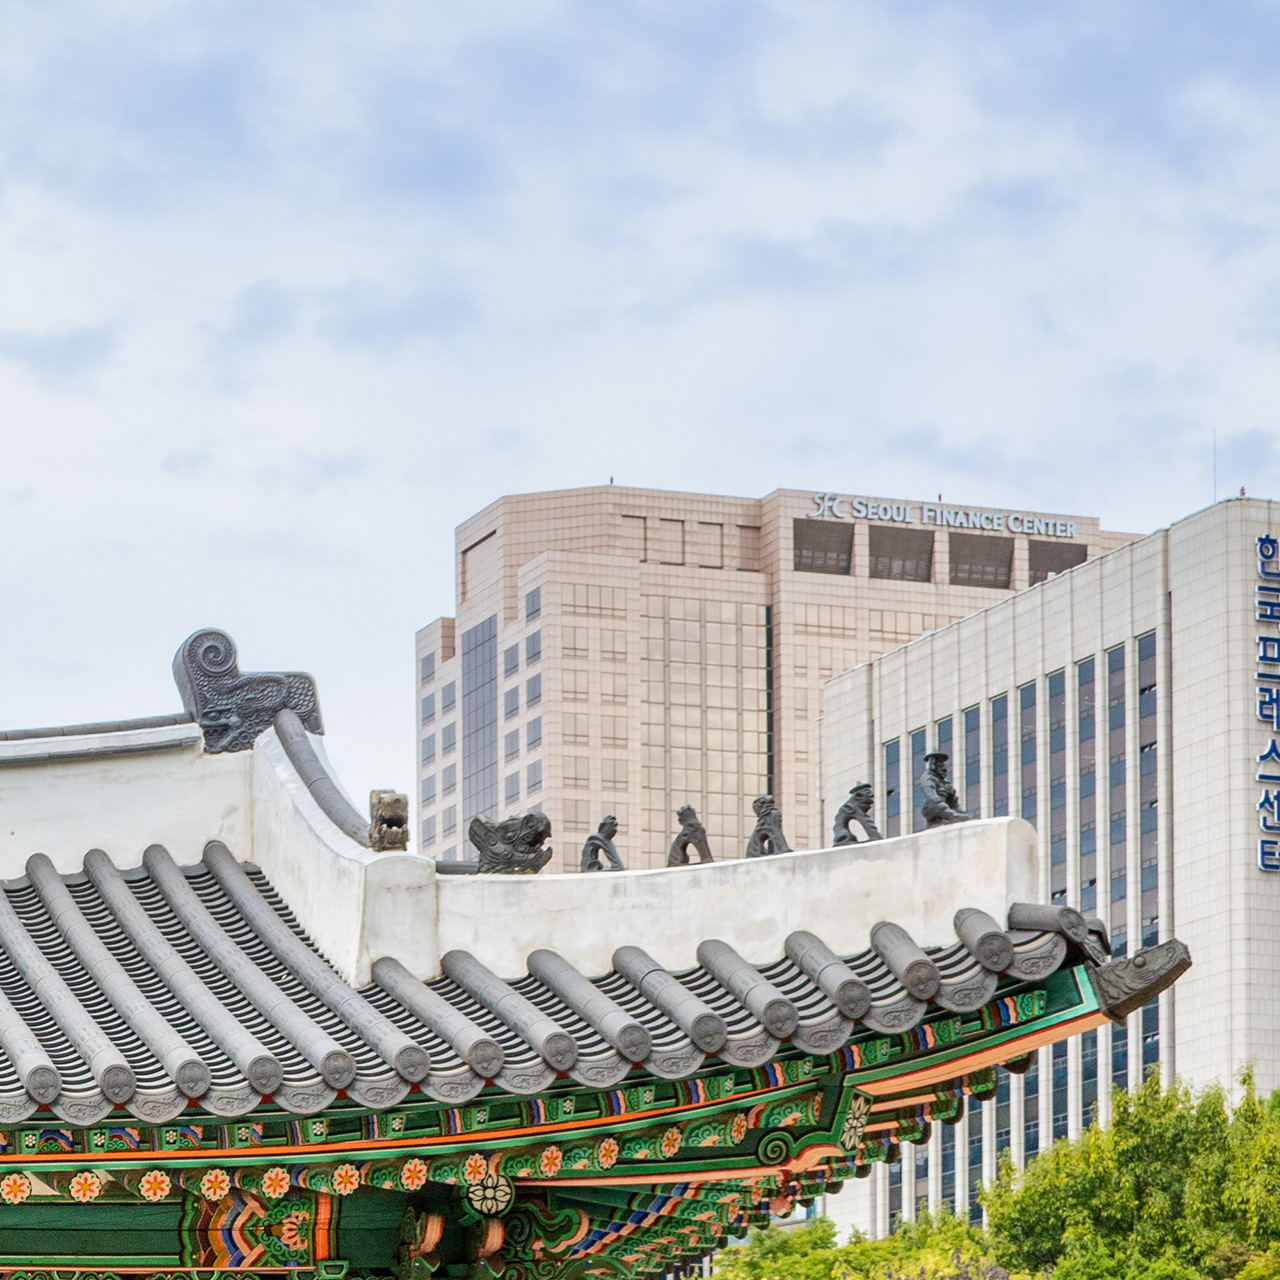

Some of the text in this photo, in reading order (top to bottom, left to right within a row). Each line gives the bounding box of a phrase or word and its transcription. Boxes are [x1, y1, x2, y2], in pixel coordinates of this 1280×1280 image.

[852, 497, 917, 522] SEOUL
[922, 503, 1004, 531] FINANCE
[1007, 512, 1077, 538] CENTER
